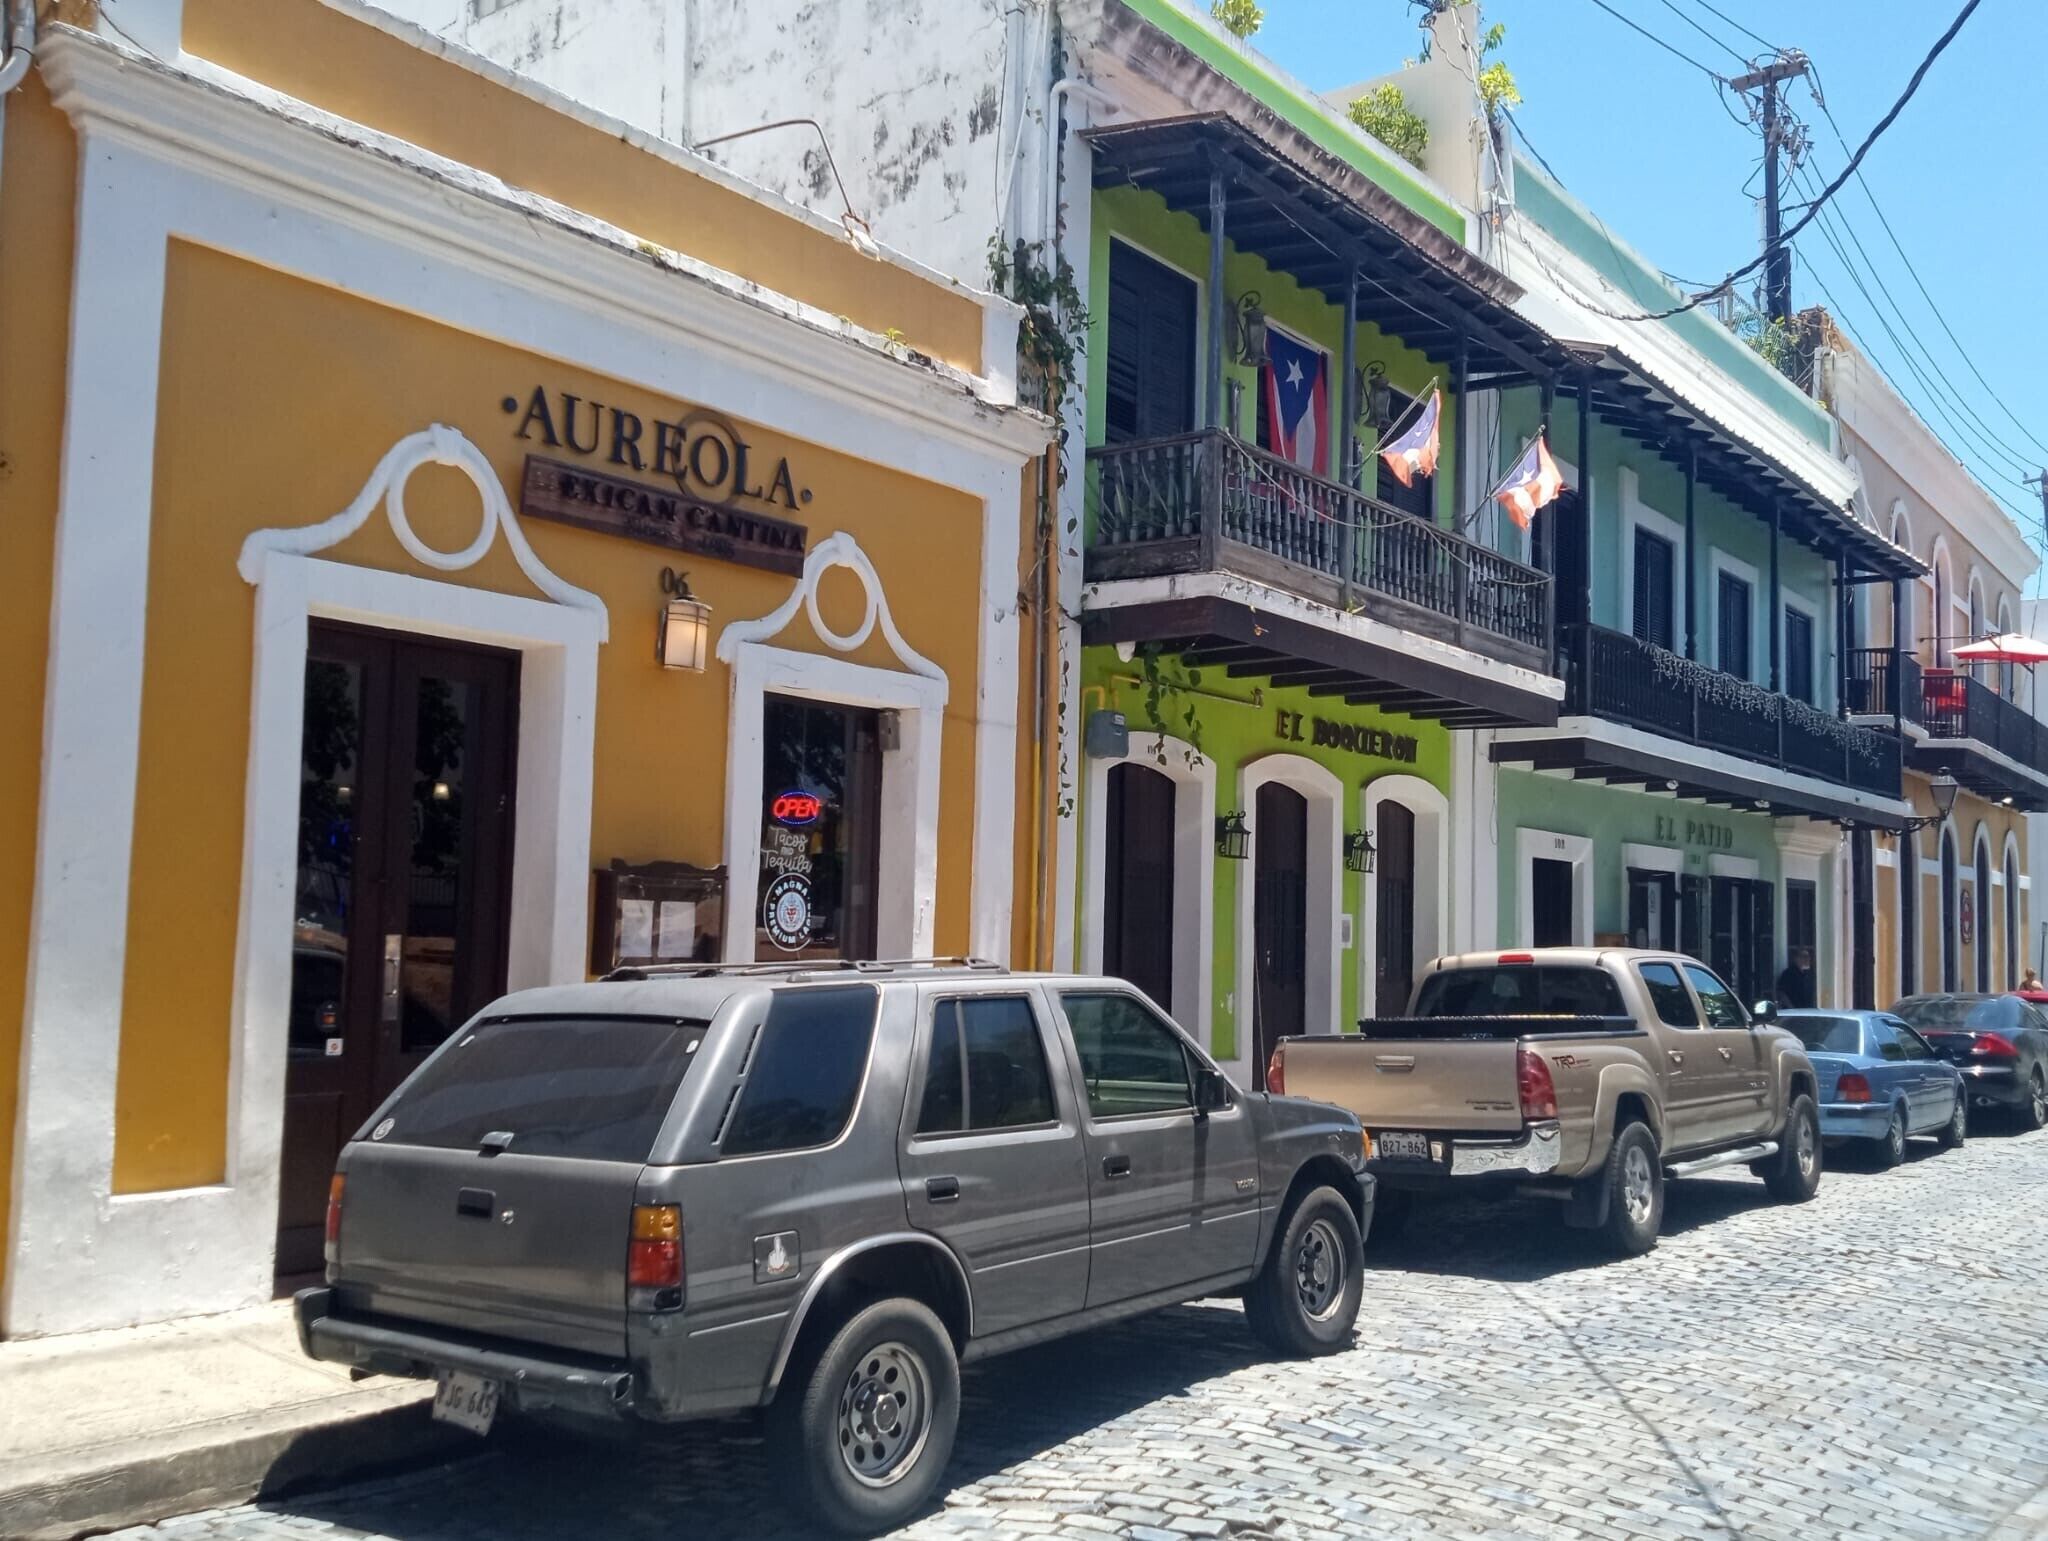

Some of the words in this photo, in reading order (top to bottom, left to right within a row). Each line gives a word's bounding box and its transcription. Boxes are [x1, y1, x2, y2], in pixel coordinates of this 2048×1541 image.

[685, 506, 804, 551] CANTINA
[1277, 709, 1304, 742] EL
[773, 798, 820, 817] OPEN
[768, 825, 808, 852] Tacos
[1655, 815, 1677, 841] EL
[1685, 819, 1733, 849] PATIO
[760, 848, 813, 874] Tequila
[774, 880, 809, 898] MAGNA
[768, 903, 797, 944] PREMIUM
[1552, 1055, 1576, 1069] TRD
